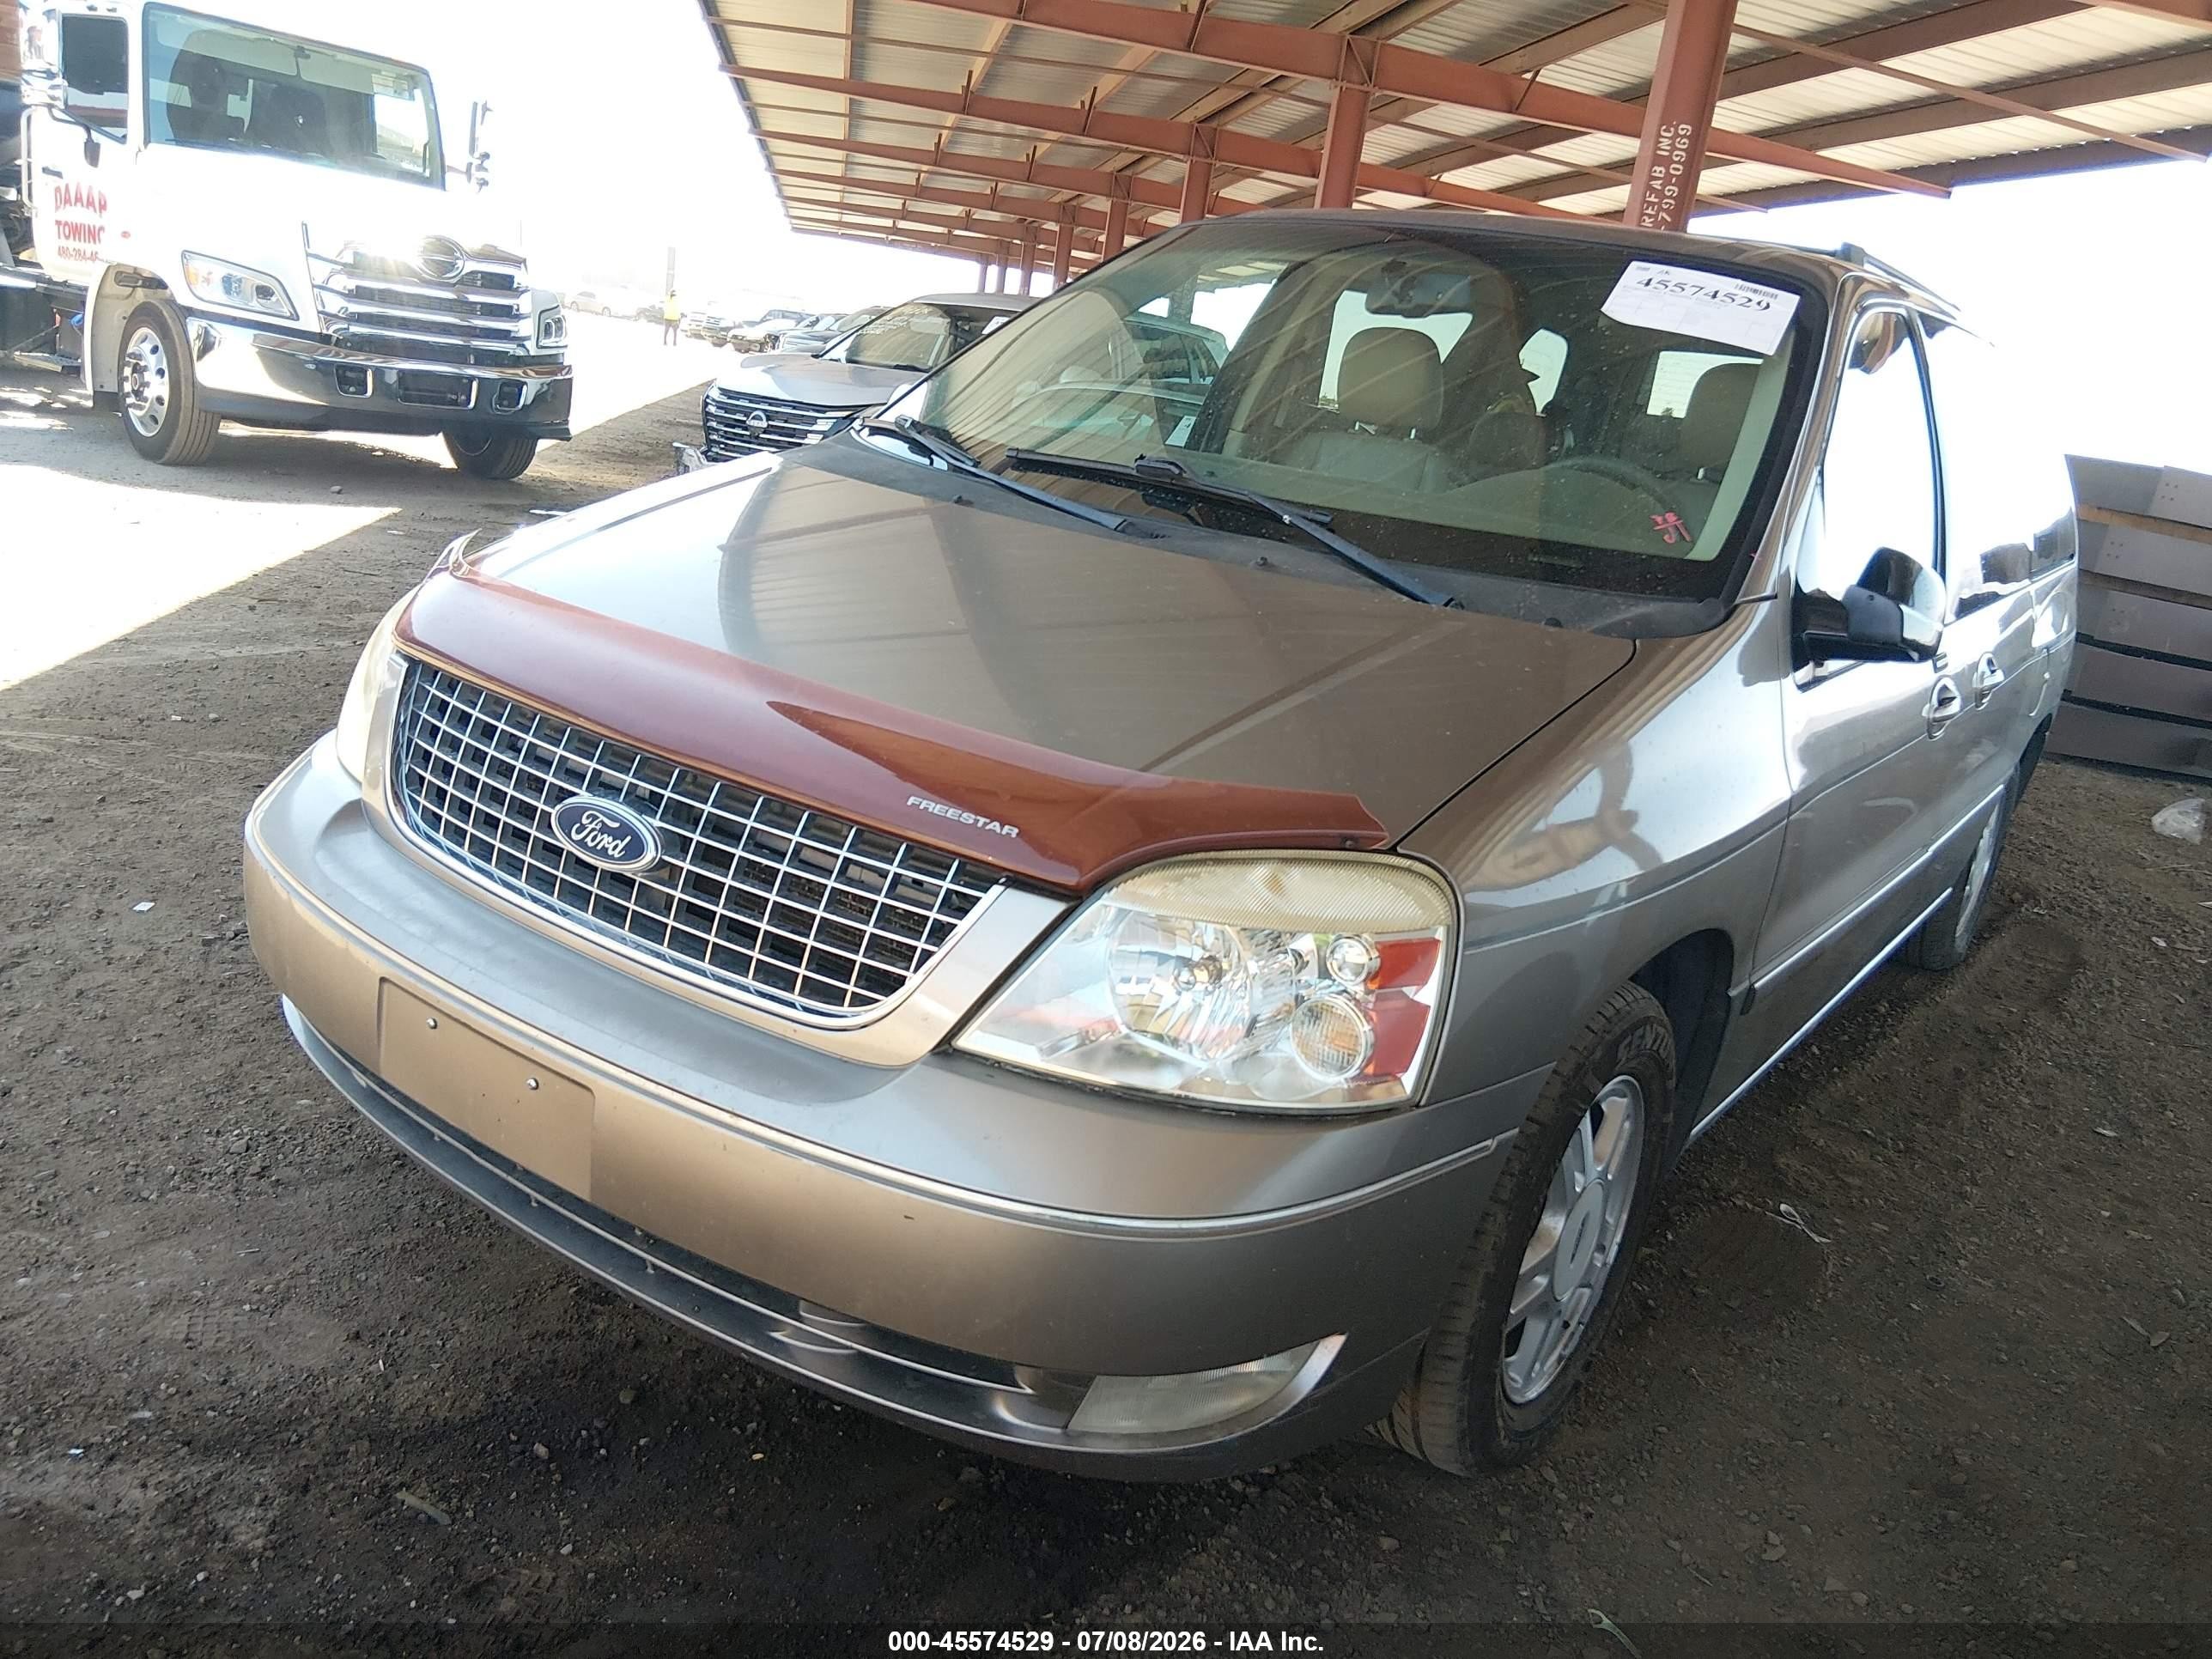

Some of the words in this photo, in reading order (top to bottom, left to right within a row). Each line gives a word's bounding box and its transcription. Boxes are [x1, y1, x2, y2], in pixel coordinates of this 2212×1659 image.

[1656, 120, 1677, 156] INC.
[1636, 277, 1771, 311] 45574529
[571, 810, 632, 858] Ford
[906, 795, 1019, 838] FREESTAR
